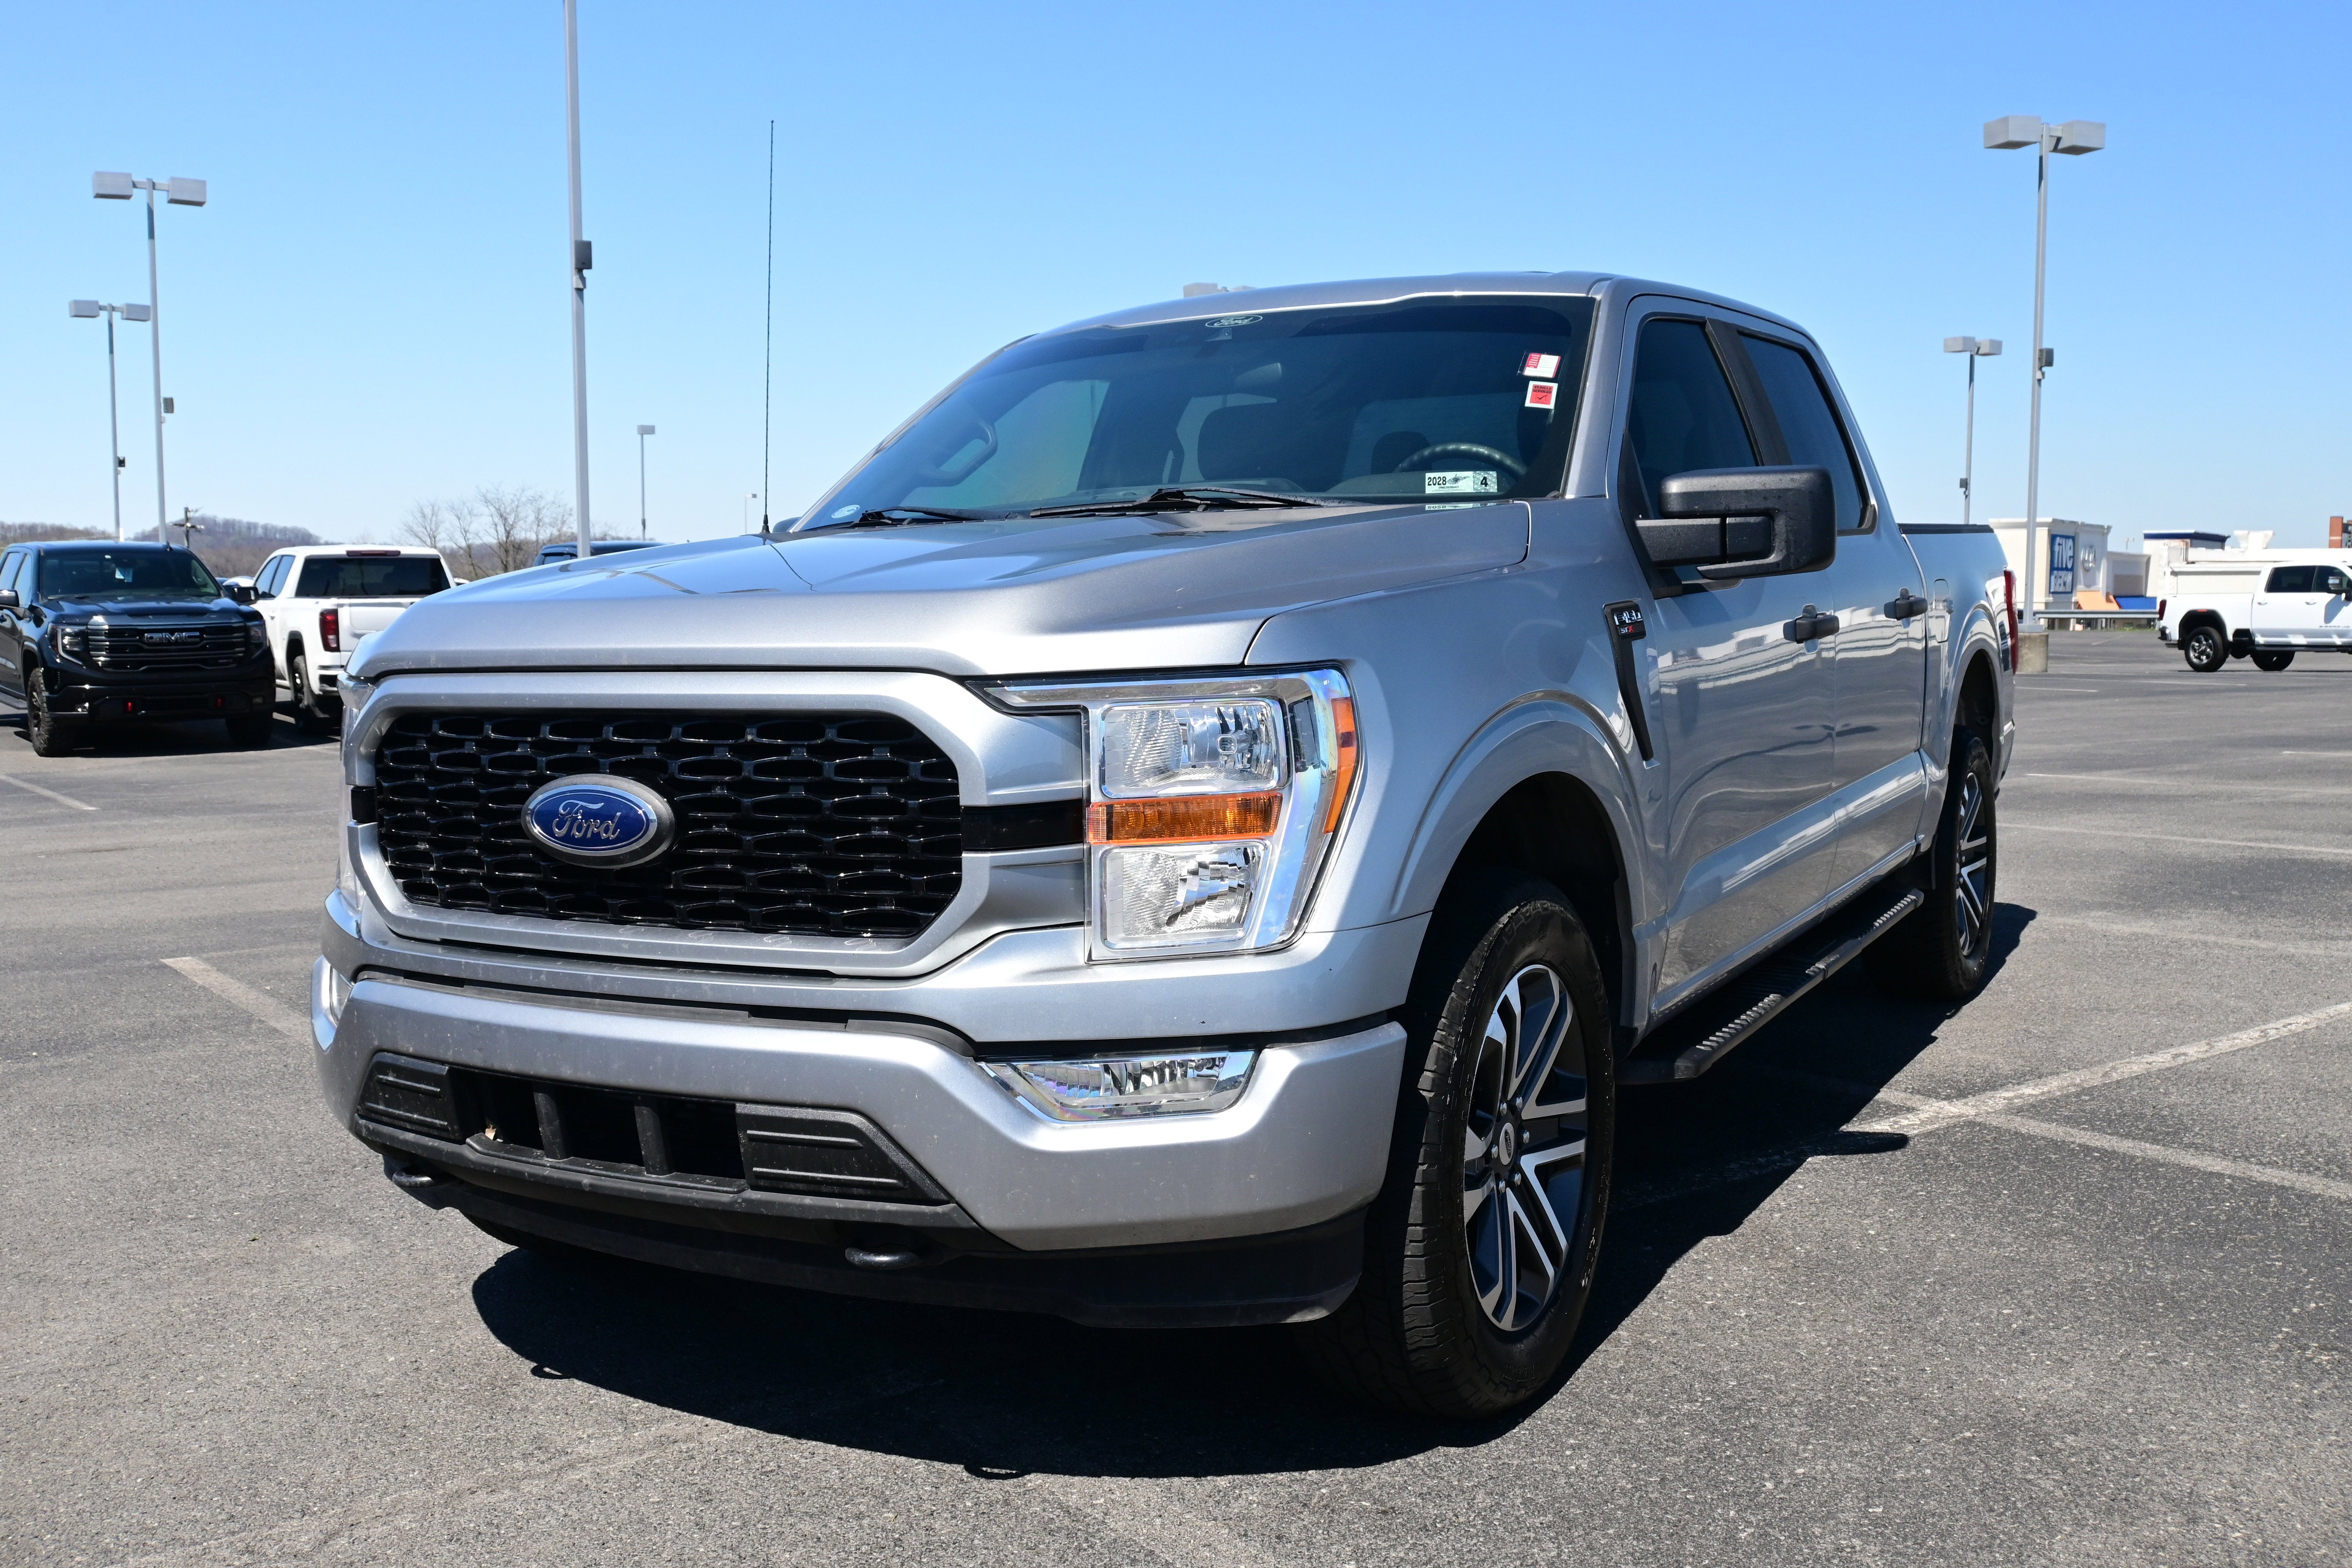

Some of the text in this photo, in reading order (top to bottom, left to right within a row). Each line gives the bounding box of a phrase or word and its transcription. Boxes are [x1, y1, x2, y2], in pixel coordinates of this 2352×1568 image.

[1214, 317, 1254, 326] Ford
[1427, 476, 1489, 487] 2028 4
[2055, 536, 2074, 569] five
[1620, 625, 1633, 634] STX
[144, 632, 200, 642] GMC
[553, 800, 621, 840] Ford
